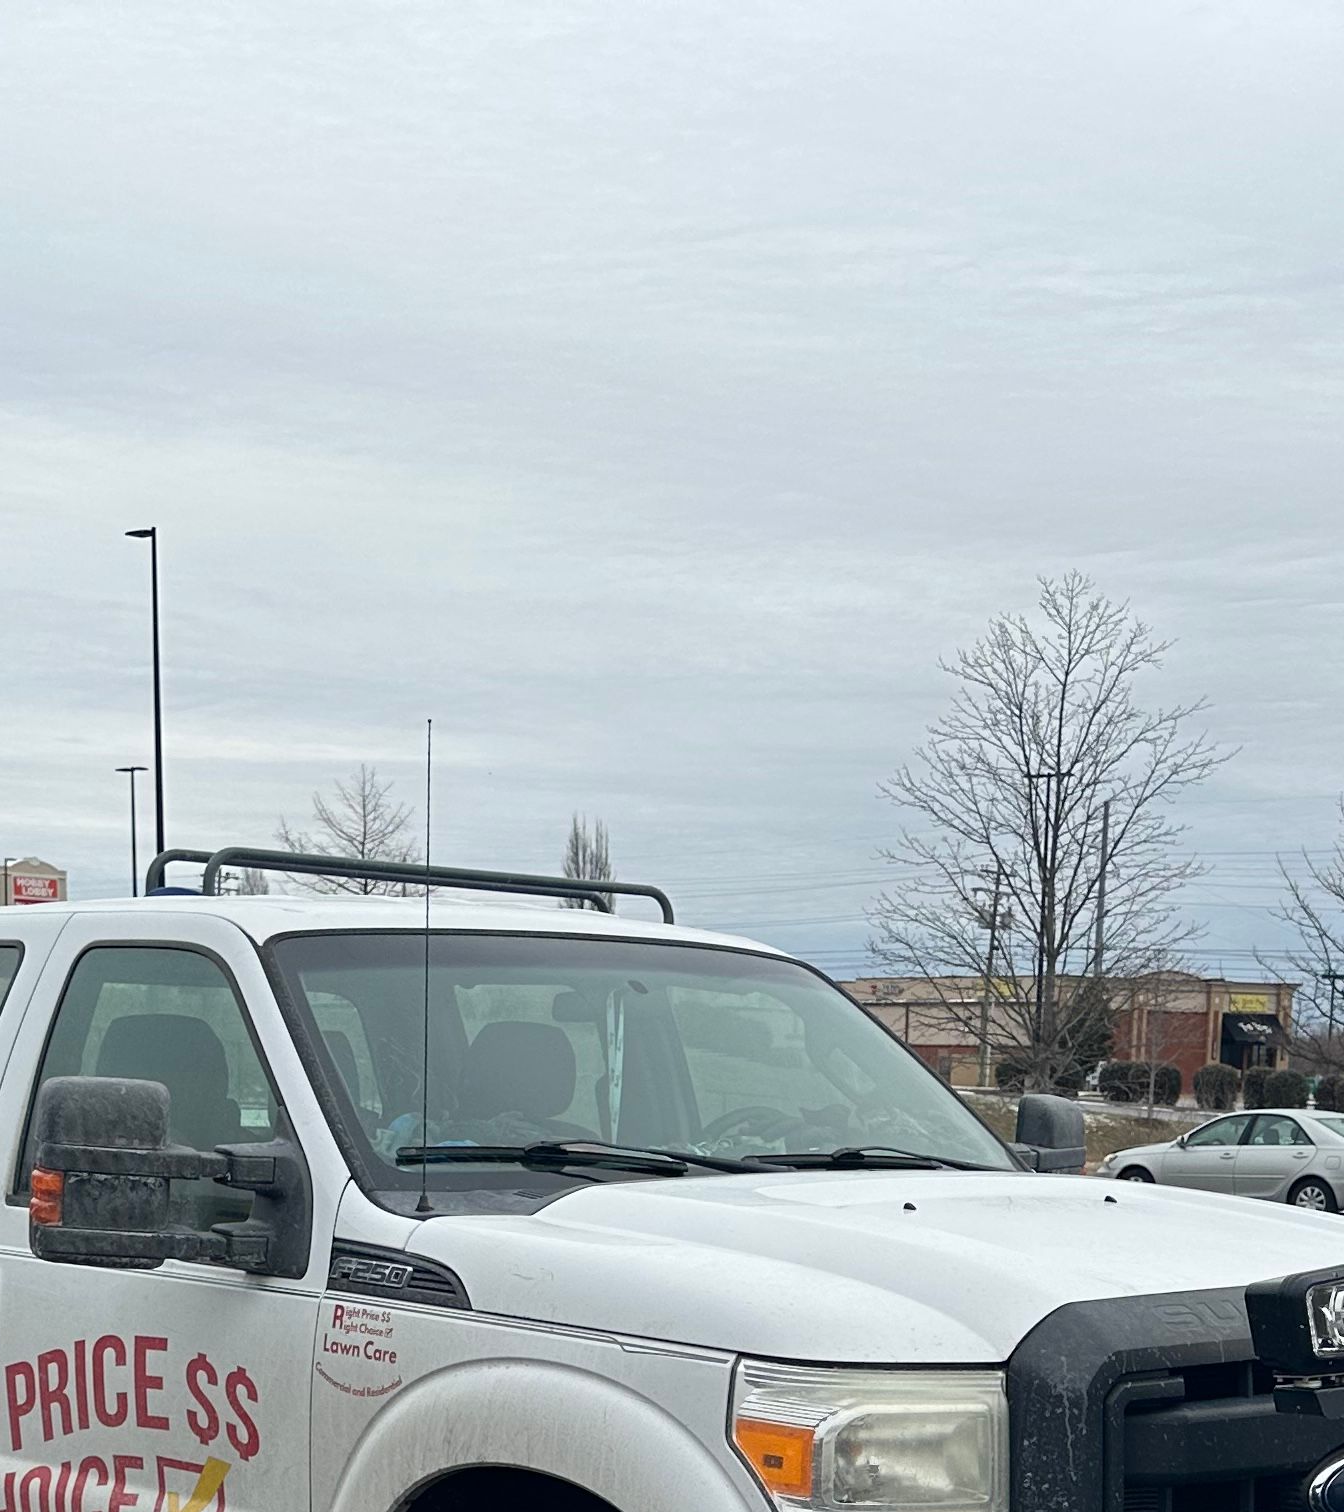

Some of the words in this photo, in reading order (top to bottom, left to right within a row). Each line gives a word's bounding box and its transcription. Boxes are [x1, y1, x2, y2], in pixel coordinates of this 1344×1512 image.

[359, 1323, 384, 1337] Choice
[362, 1308, 379, 1322] Price
[381, 1311, 391, 1323] $$
[323, 1333, 360, 1358] Lawn
[363, 1340, 397, 1364] Care
[315, 1362, 351, 1393] Commercial
[352, 1386, 365, 1397] and
[366, 1375, 403, 1397] Residential
[4, 1334, 170, 1451] PRICE
[185, 1352, 260, 1461] $$
